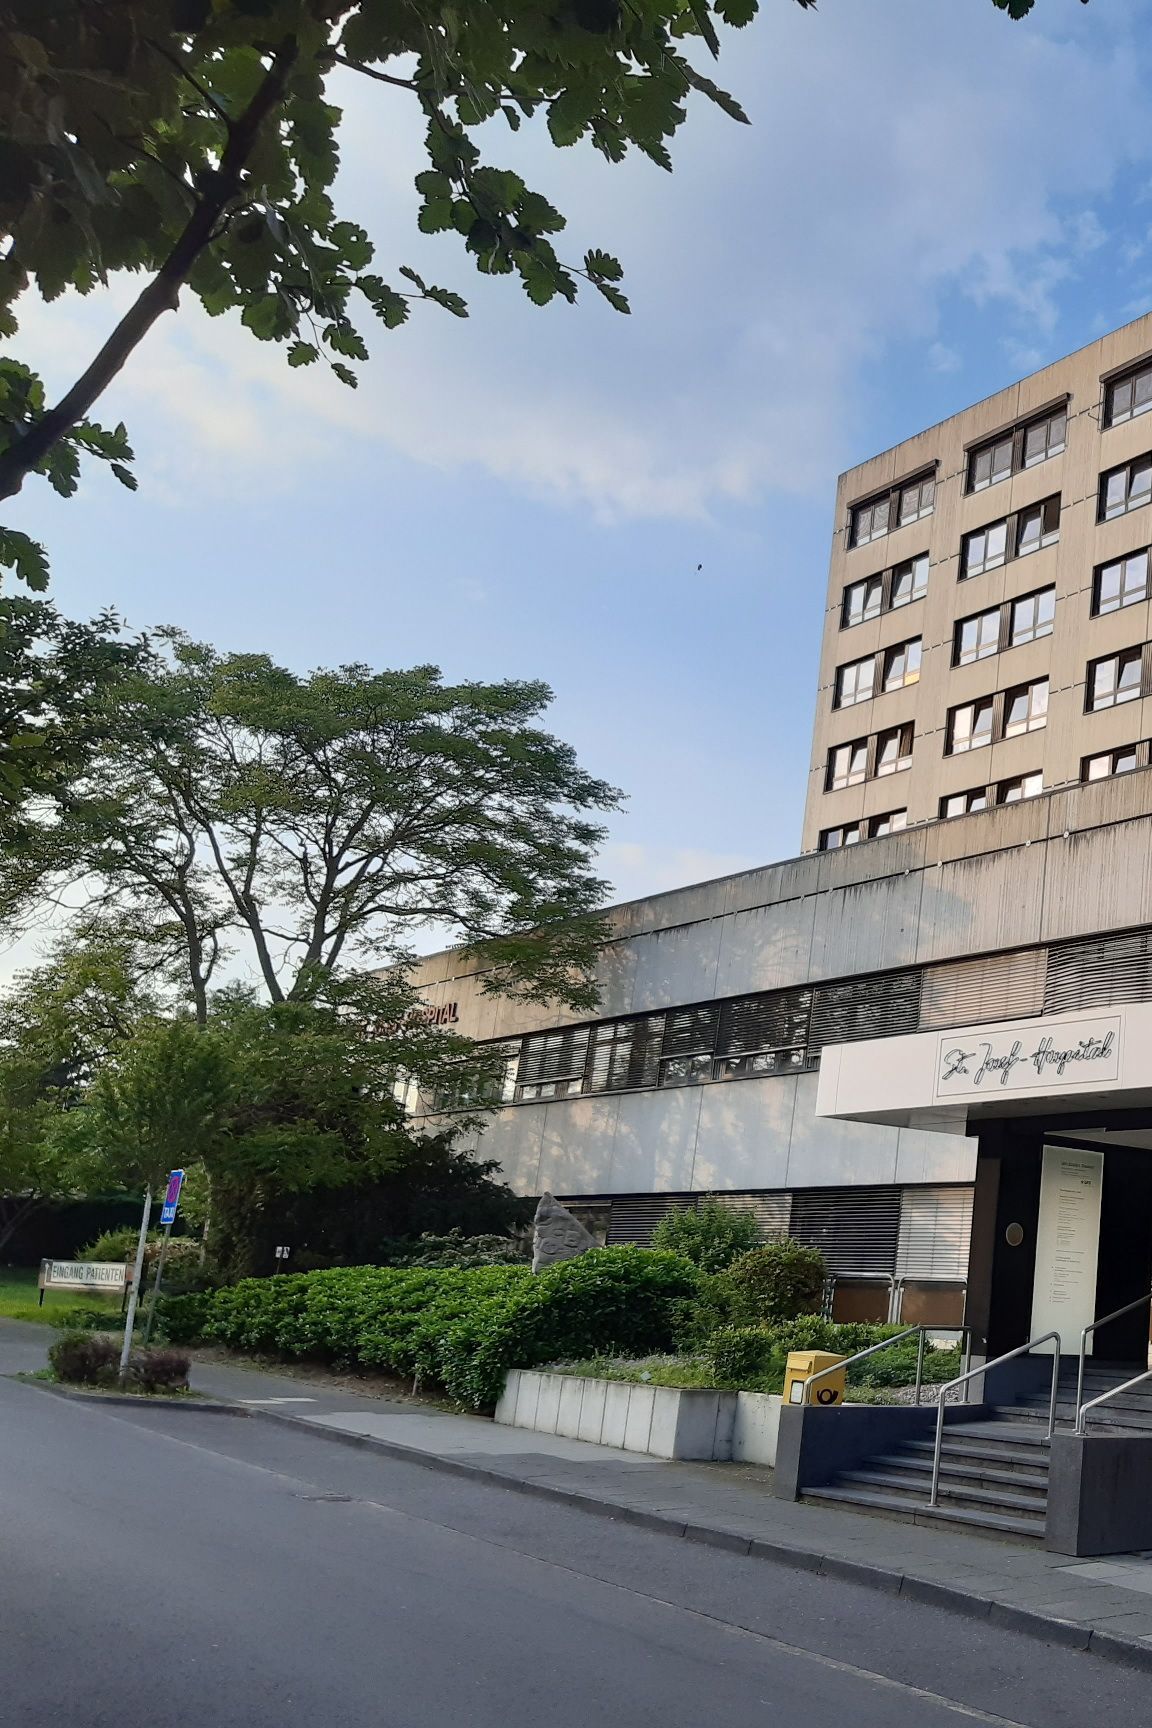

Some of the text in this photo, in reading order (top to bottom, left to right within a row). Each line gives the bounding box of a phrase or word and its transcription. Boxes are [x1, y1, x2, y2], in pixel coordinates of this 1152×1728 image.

[941, 1048, 976, 1080] St.
[52, 1265, 125, 1282] EINGANG PATIENTEN
